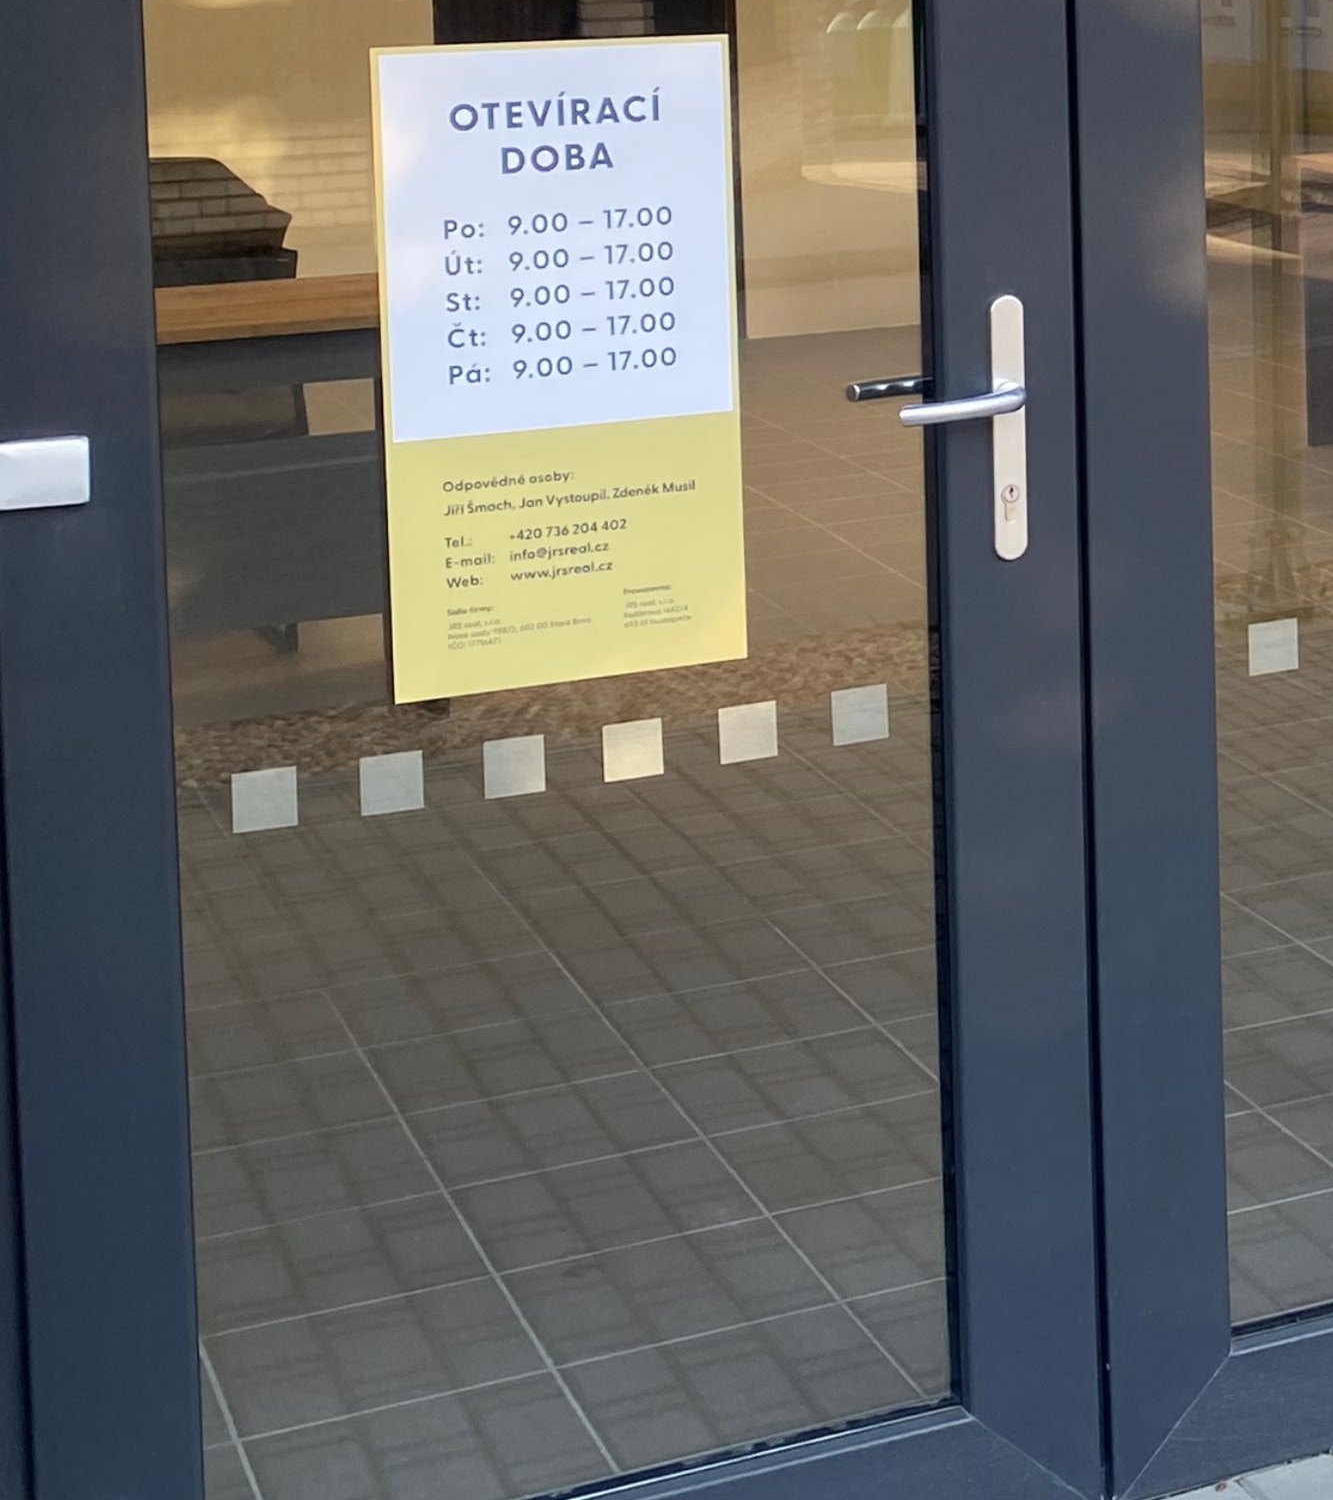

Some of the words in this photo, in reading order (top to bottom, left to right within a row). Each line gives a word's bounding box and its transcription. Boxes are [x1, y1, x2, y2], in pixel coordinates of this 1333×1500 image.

[449, 87, 662, 132] OTEVÍRACÍ
[500, 141, 615, 175] DOBA
[443, 219, 486, 240] Po:
[507, 212, 569, 236] 9.00
[602, 205, 673, 231] 17.00
[444, 250, 483, 277] Út:
[508, 248, 570, 272] 9.00
[603, 241, 674, 266] 17.00
[445, 291, 482, 313] St:
[509, 284, 571, 308] 9.00
[604, 276, 676, 301] 17.00
[447, 322, 487, 349] Čt:
[511, 319, 572, 345] 9.00
[605, 311, 677, 337] 17.00
[448, 362, 491, 386] Pá:
[512, 356, 574, 381] 9.00
[607, 347, 678, 373] 17.00
[442, 474, 526, 493] Odpovědné
[518, 497, 544, 509] Jan
[612, 484, 660, 499] Zdeněk
[662, 479, 696, 493] Musil
[545, 525, 570, 538] 736
[572, 521, 599, 535] 204
[601, 518, 627, 532] 402
[509, 541, 610, 562] info@jrsreal.cz
[446, 575, 484, 589] Web:
[510, 561, 613, 581] www.jrsreal.cz
